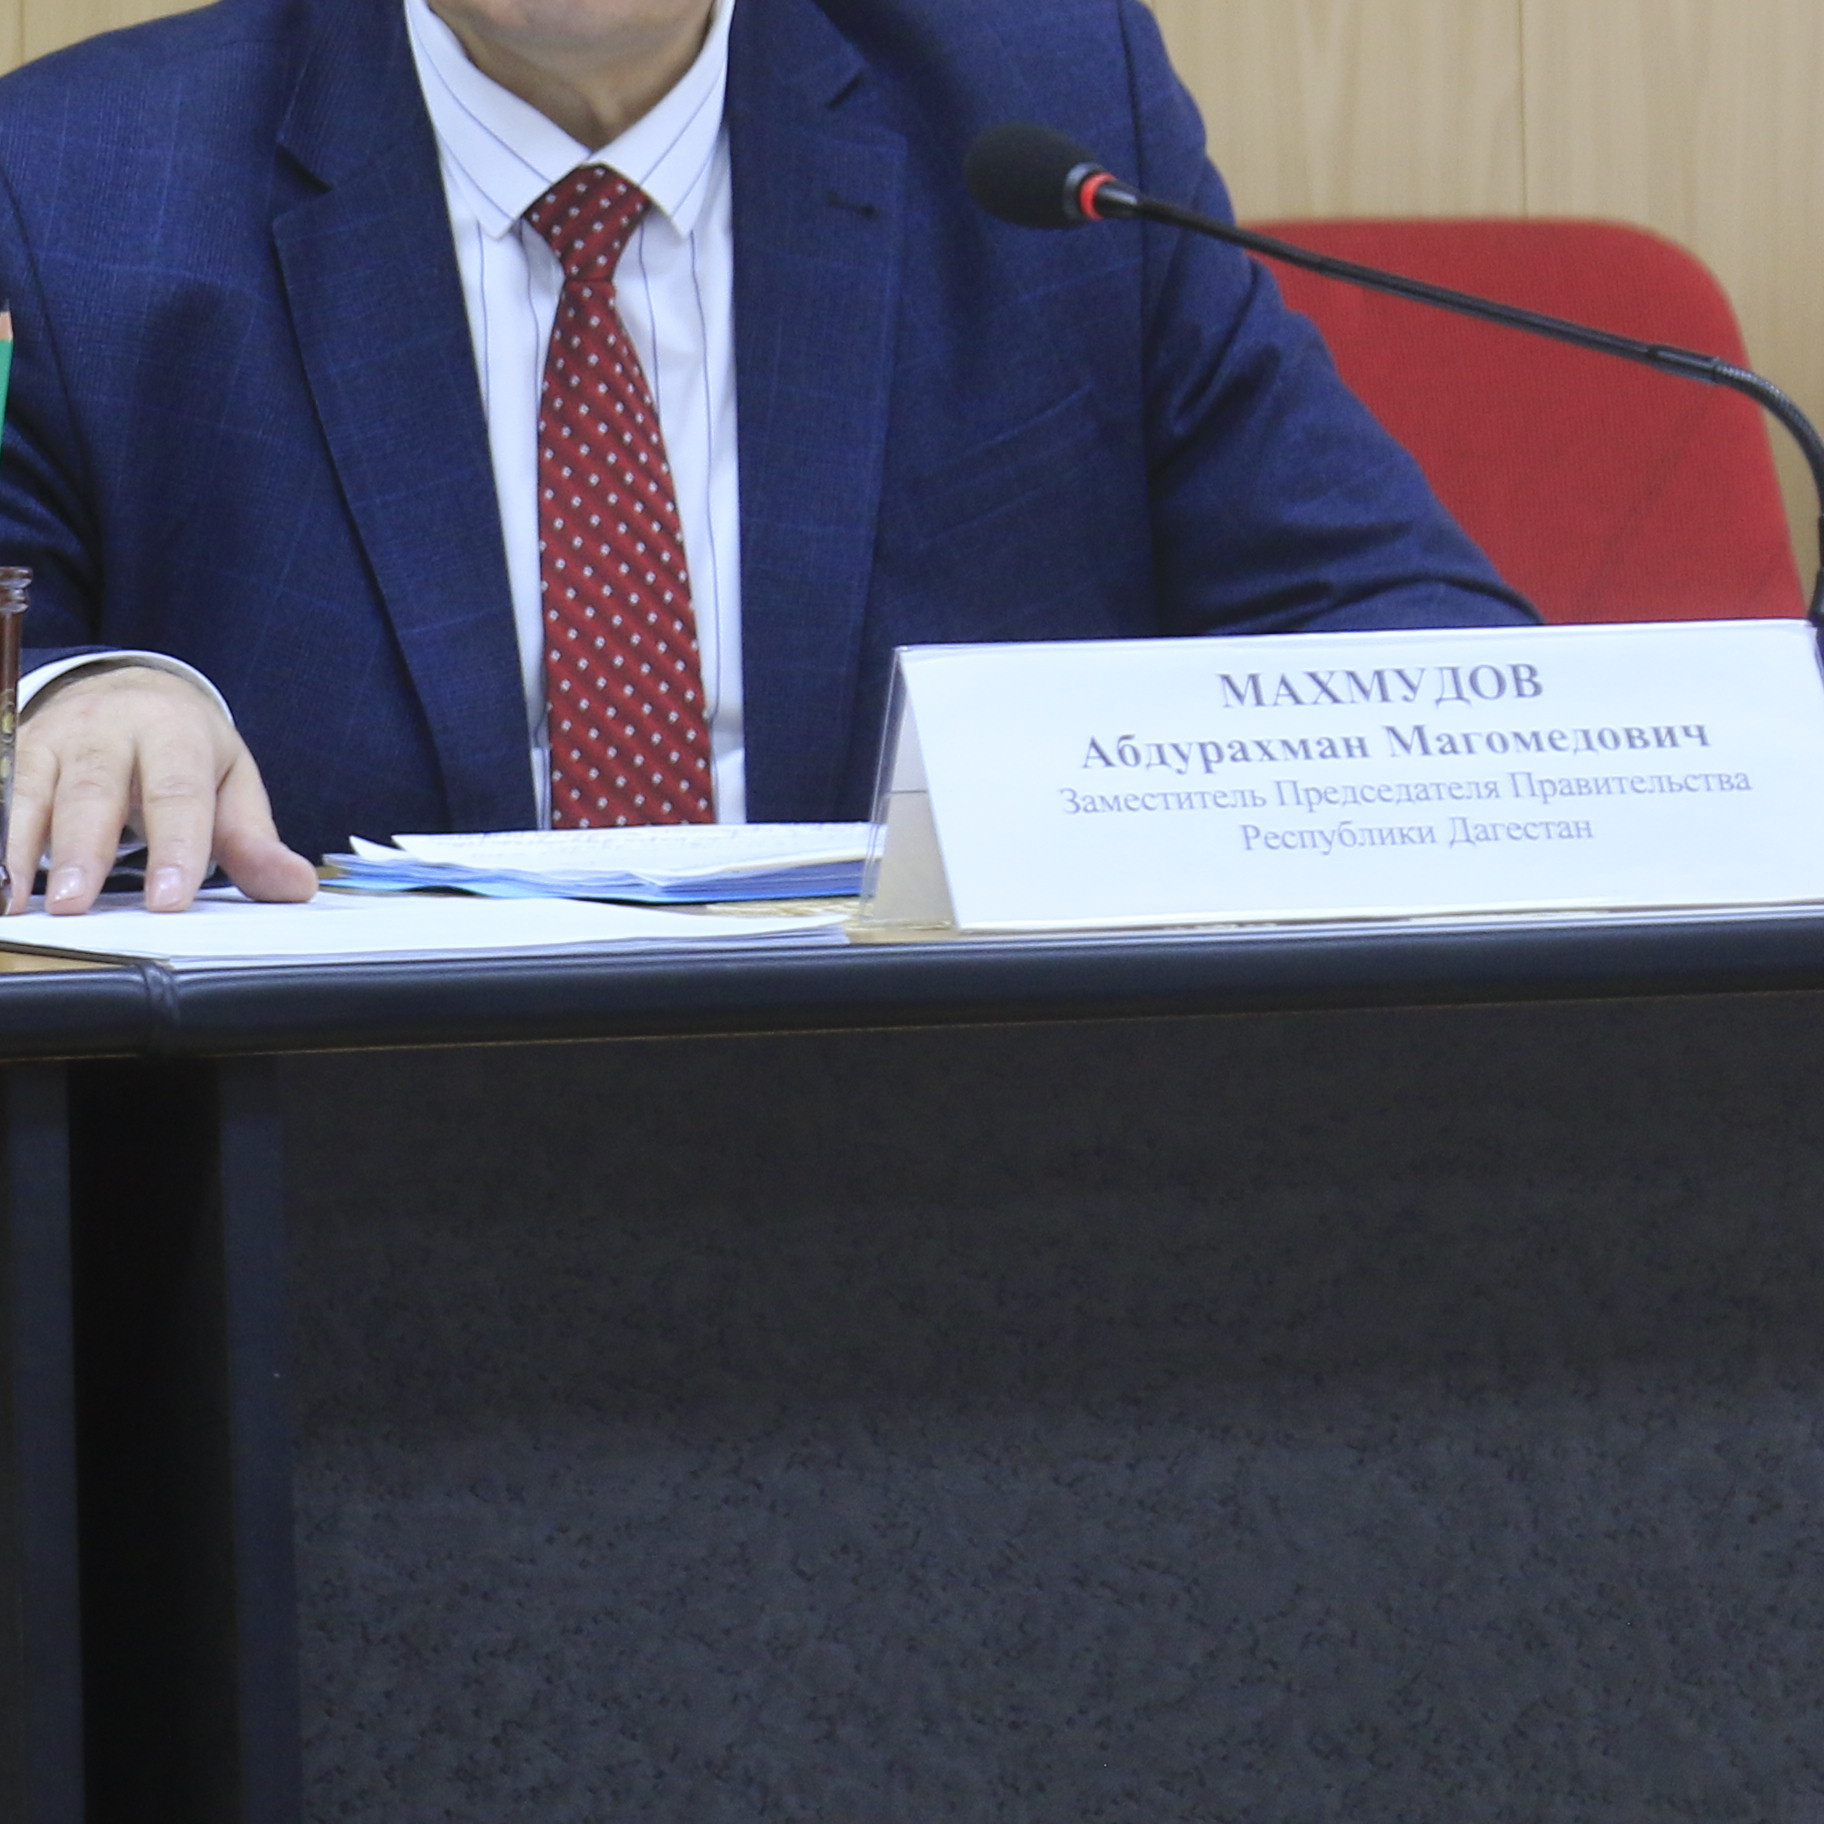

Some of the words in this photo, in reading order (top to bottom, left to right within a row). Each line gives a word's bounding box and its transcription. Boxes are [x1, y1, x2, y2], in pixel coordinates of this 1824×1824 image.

[1216, 663, 1544, 709] МАХМУДОВ
[1082, 733, 1371, 776] Абдурахман
[1382, 724, 1711, 758] Магомедович
[1059, 787, 1267, 815] Заместитель
[1274, 780, 1501, 814] Председателя
[1509, 772, 1753, 805] Правительства
[1240, 820, 1437, 856] Республики
[1448, 816, 1594, 849] Дагестан
